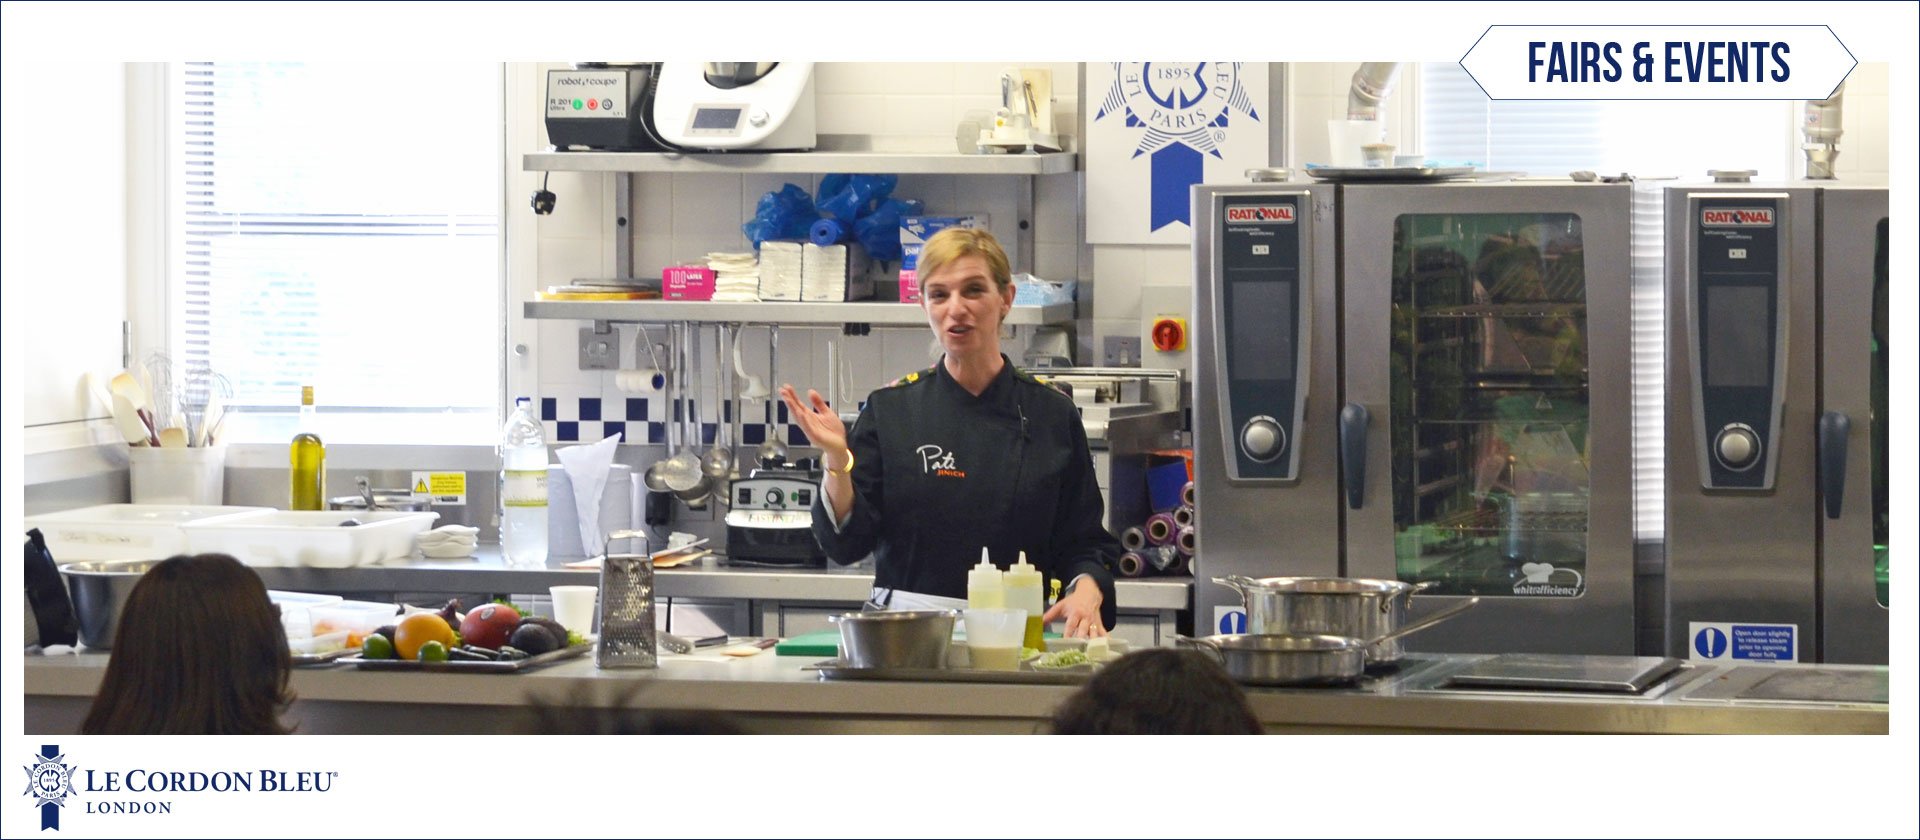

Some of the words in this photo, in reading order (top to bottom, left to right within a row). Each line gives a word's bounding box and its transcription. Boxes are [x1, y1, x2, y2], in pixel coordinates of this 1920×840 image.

[1158, 68, 1191, 80] 1895
[589, 78, 618, 87] coupe
[1150, 108, 1207, 128] PARIS
[1229, 207, 1292, 220] RATIONAL
[1704, 211, 1772, 224] RATIONAL
[670, 270, 687, 284] 100
[916, 444, 956, 474] Pati
[1769, 630, 1790, 638] slightly
